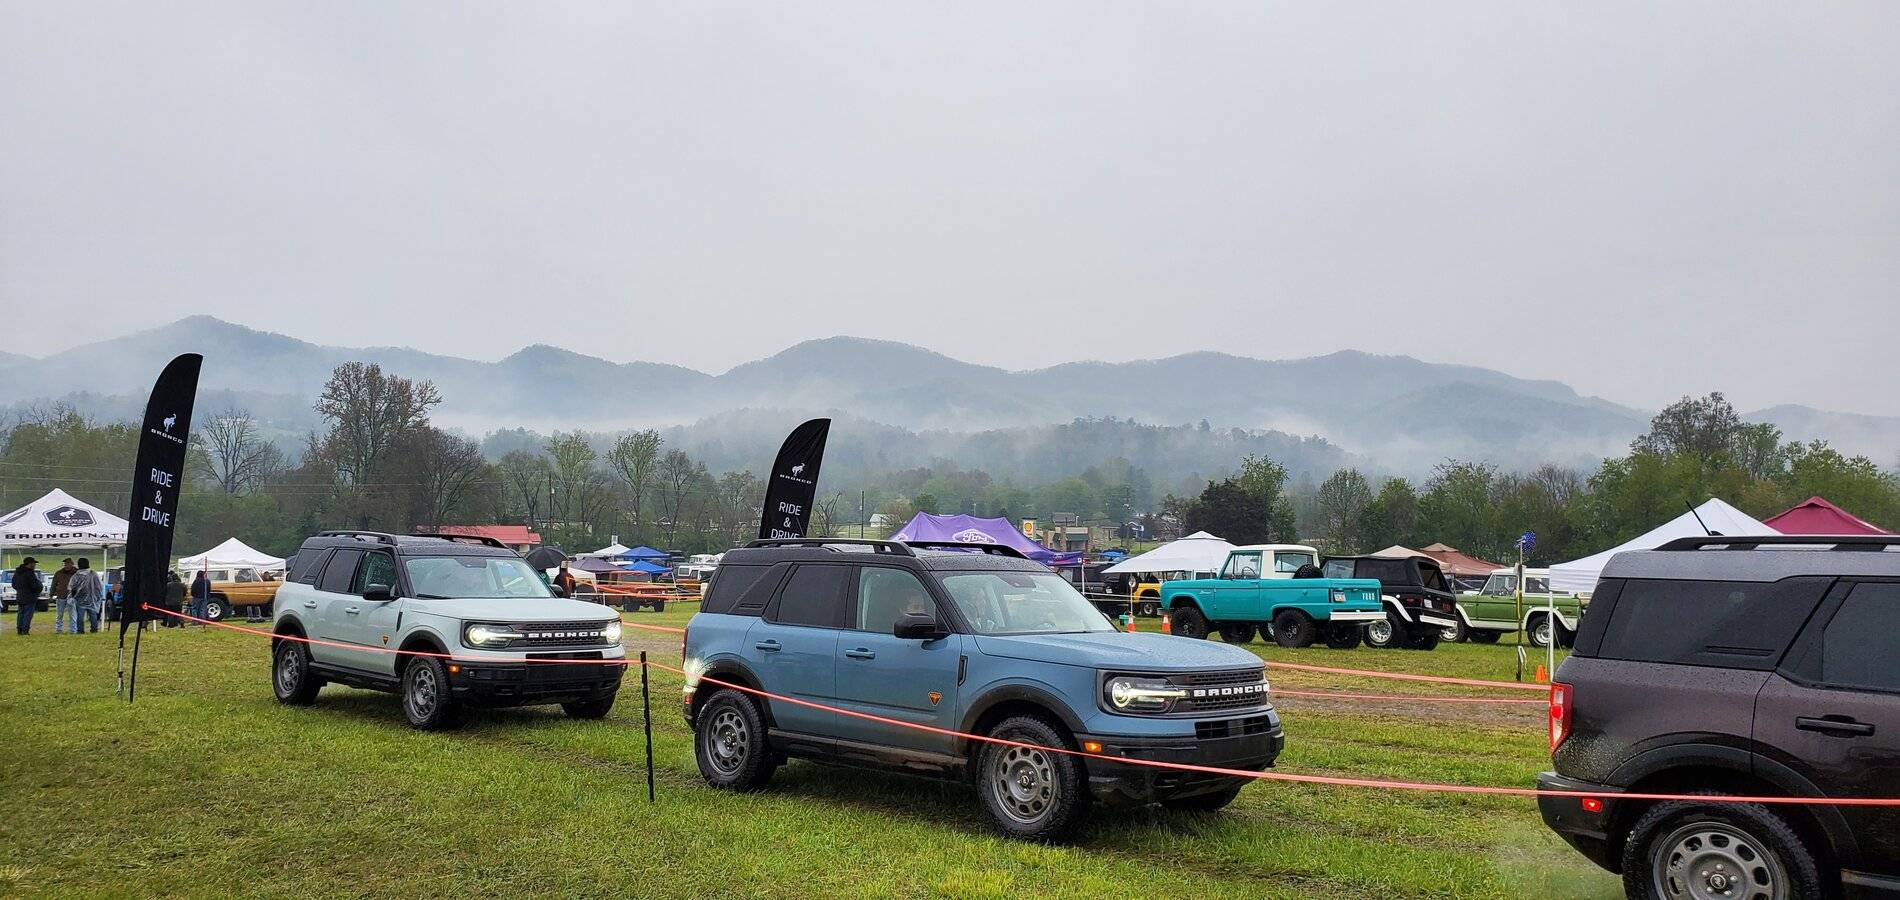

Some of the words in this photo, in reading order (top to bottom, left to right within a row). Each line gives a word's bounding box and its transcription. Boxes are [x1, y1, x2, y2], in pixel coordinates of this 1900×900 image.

[151, 428, 183, 443] BRONCO
[151, 468, 173, 487] RIDE
[154, 490, 163, 505] &
[778, 501, 802, 516] RIDE
[142, 506, 170, 527] DRIVE
[783, 517, 792, 528] &
[5, 532, 83, 540] BRONCO
[1193, 685, 1262, 697] BRONCO
